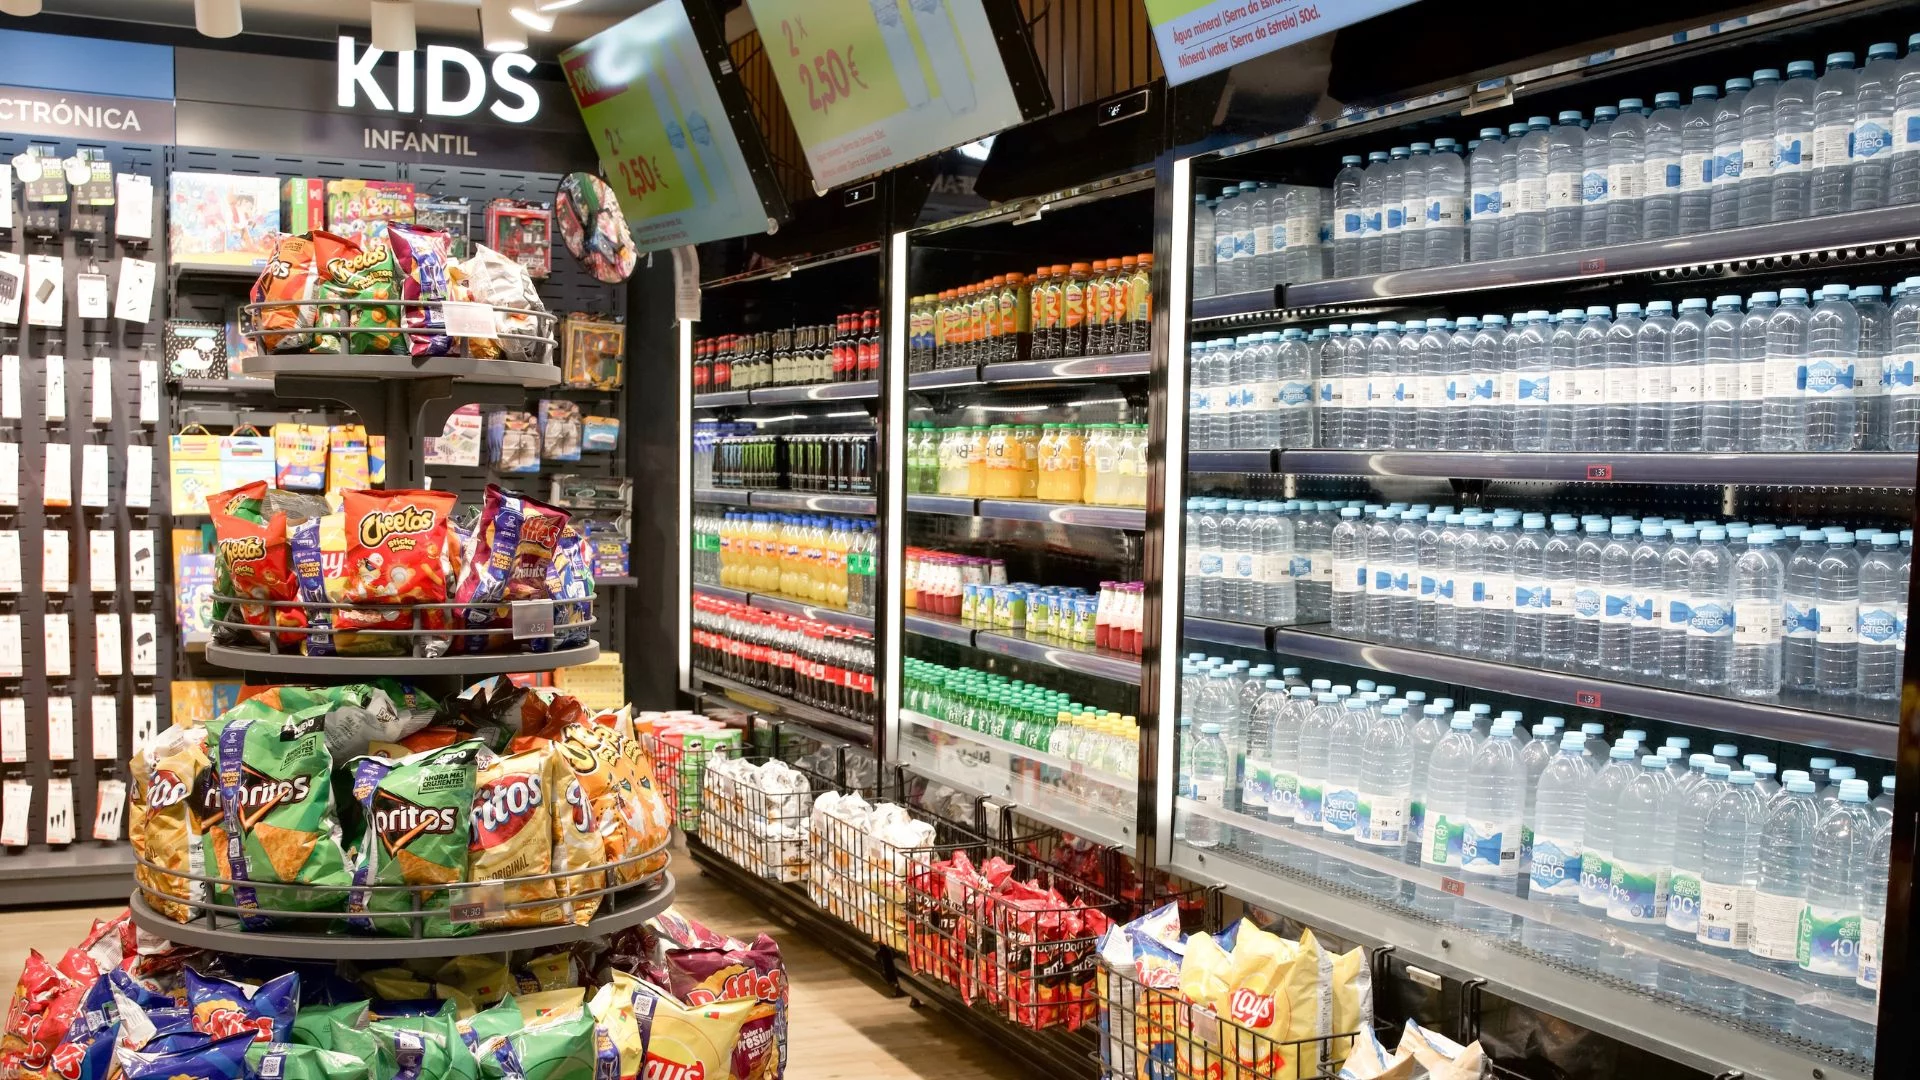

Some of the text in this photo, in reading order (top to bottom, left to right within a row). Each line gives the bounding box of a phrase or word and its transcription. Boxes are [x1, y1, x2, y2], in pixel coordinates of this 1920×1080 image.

[781, 19, 799, 58] 2
[1173, 26, 1193, 45] Água
[1193, 16, 1222, 36] mineral
[1223, 10, 1247, 26] (Serra
[1248, 3, 1260, 15] da
[1178, 4, 1321, 68] Mineral water (Serra da Estrela) 50cl.
[338, 36, 540, 123] KIDS
[364, 128, 477, 156] INFANTIL
[604, 128, 619, 156] 2
[361, 506, 434, 547] Cheetos
[220, 537, 264, 569] Cheetos
[424, 773, 448, 781] AHORA
[492, 854, 530, 880] ORIGINAL
[1232, 989, 1273, 1028] Lay's
[743, 1029, 758, 1040] Sabor
